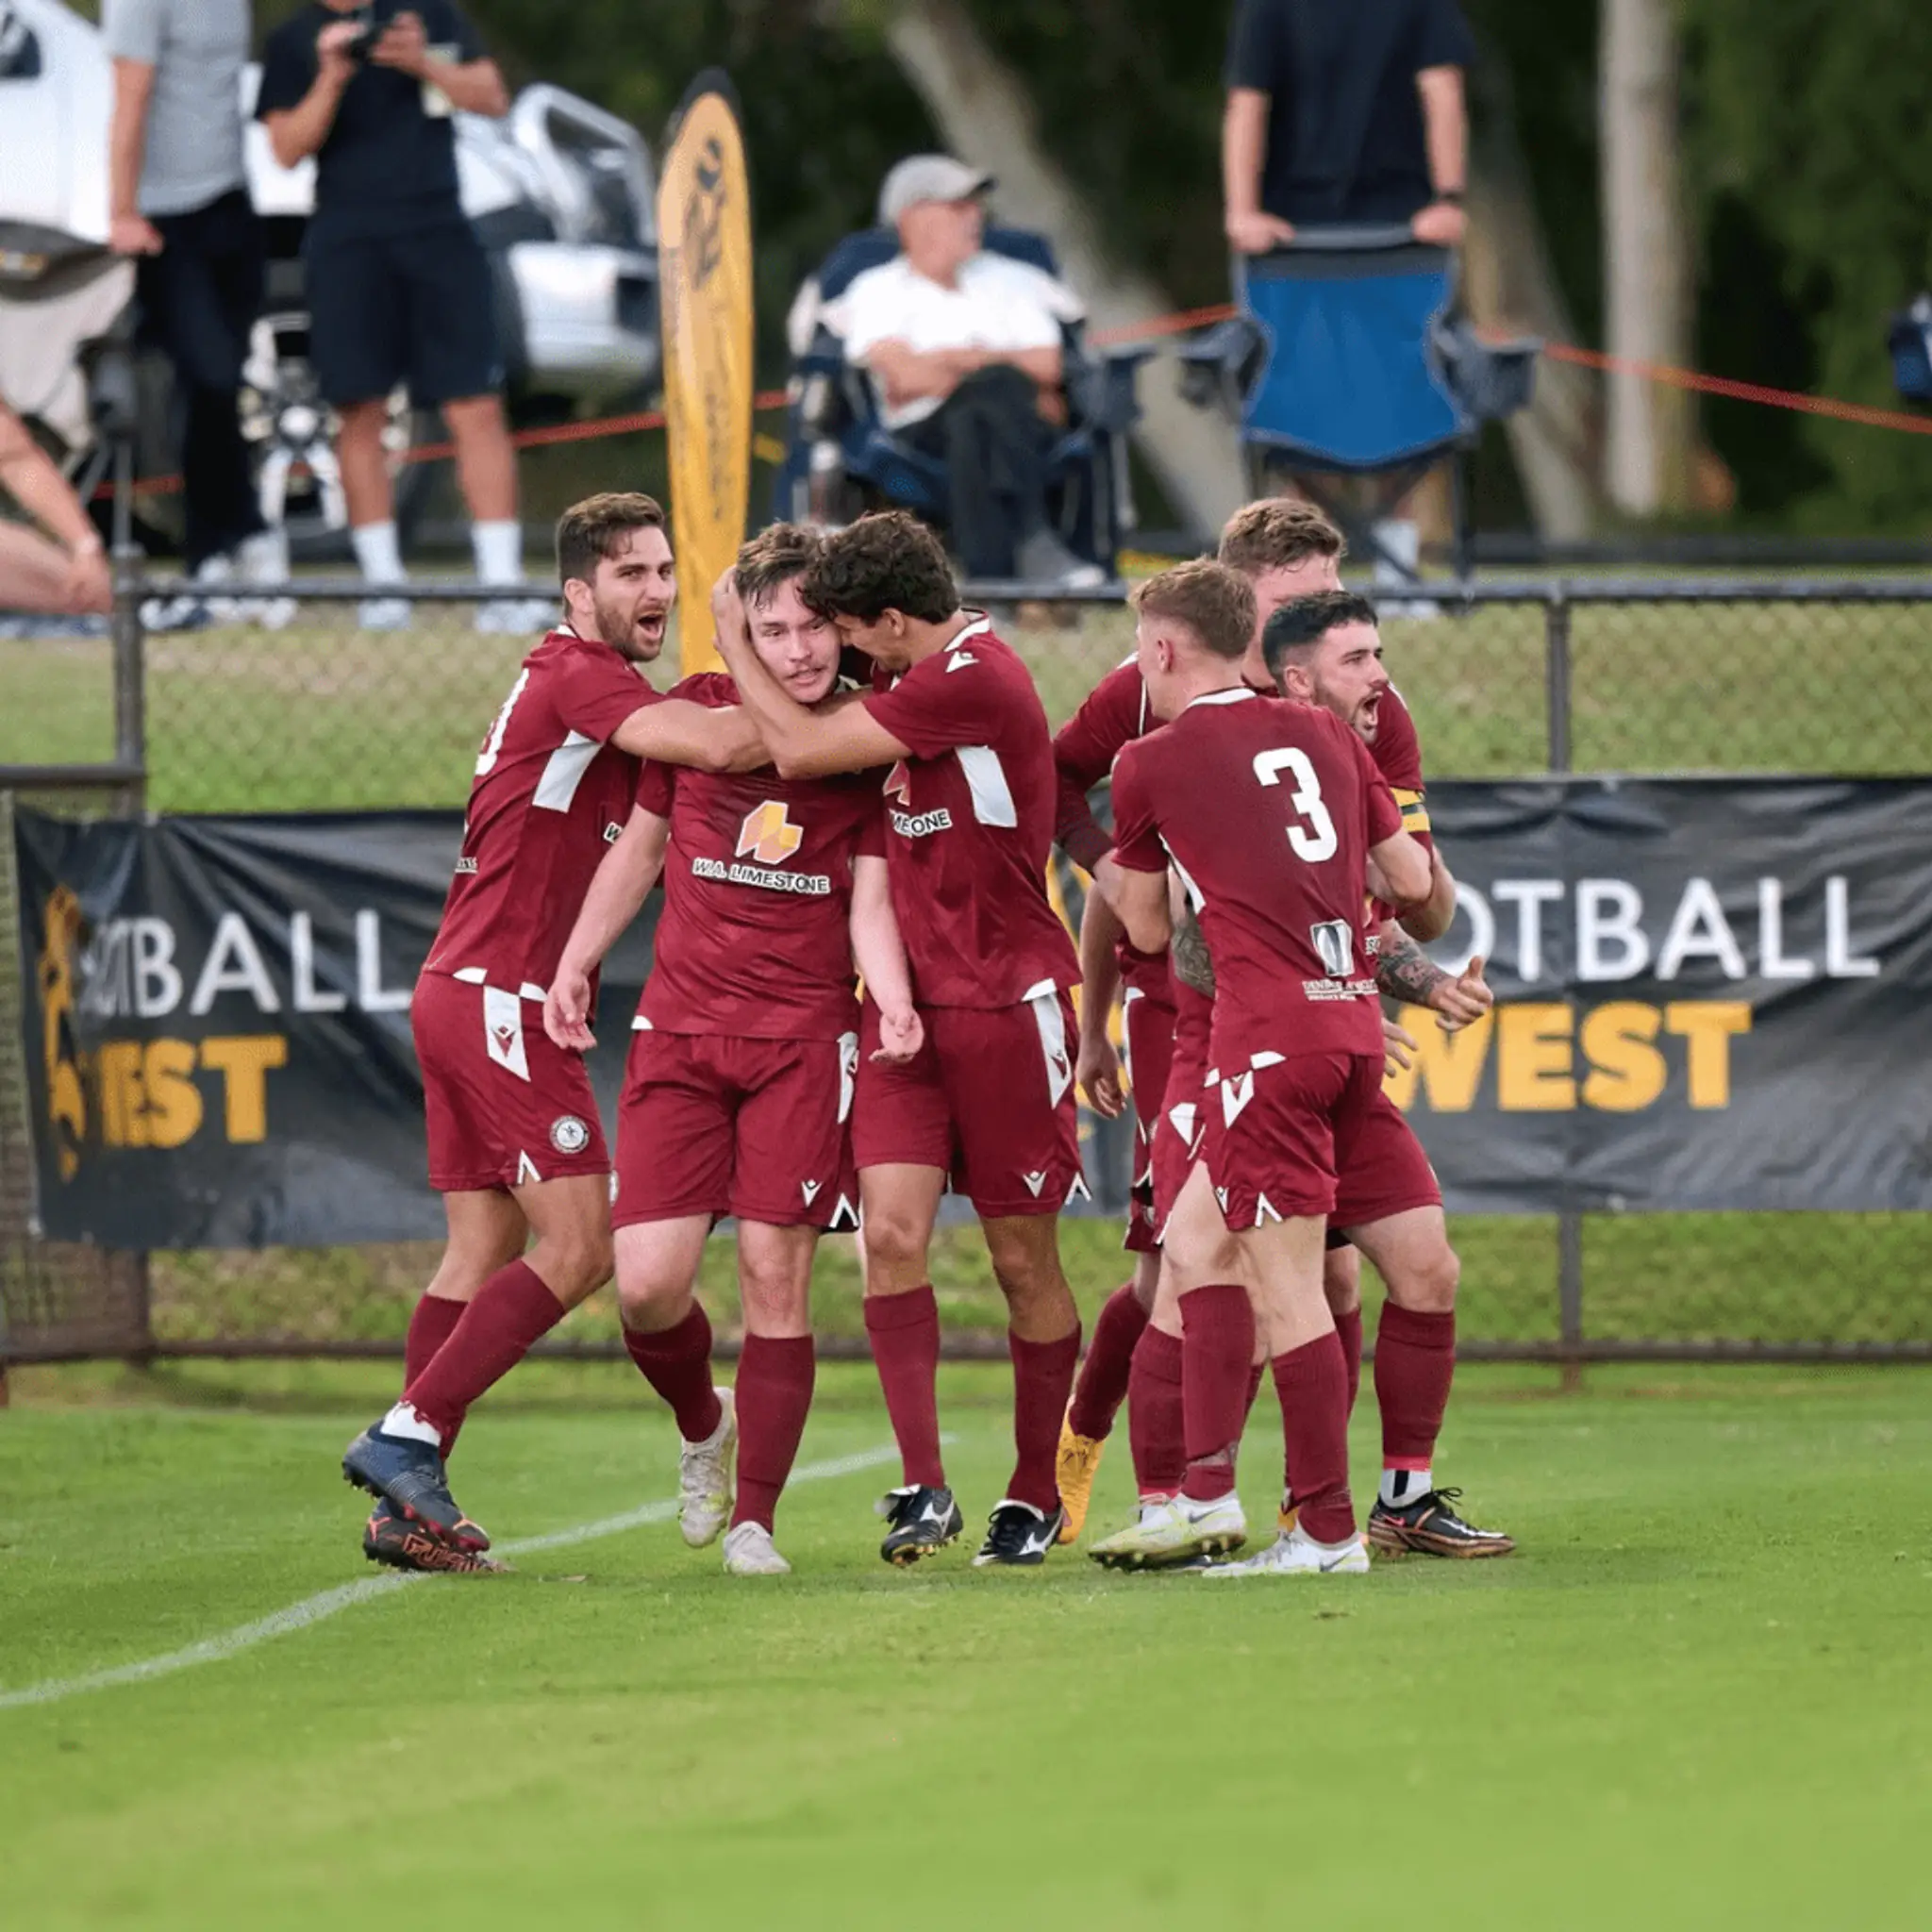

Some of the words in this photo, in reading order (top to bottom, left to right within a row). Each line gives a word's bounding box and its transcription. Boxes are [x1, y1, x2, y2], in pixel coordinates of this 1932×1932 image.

[1253, 747, 1338, 863] 3
[730, 865, 829, 893] LIMESTONE
[1381, 1001, 1753, 1112] WEST
